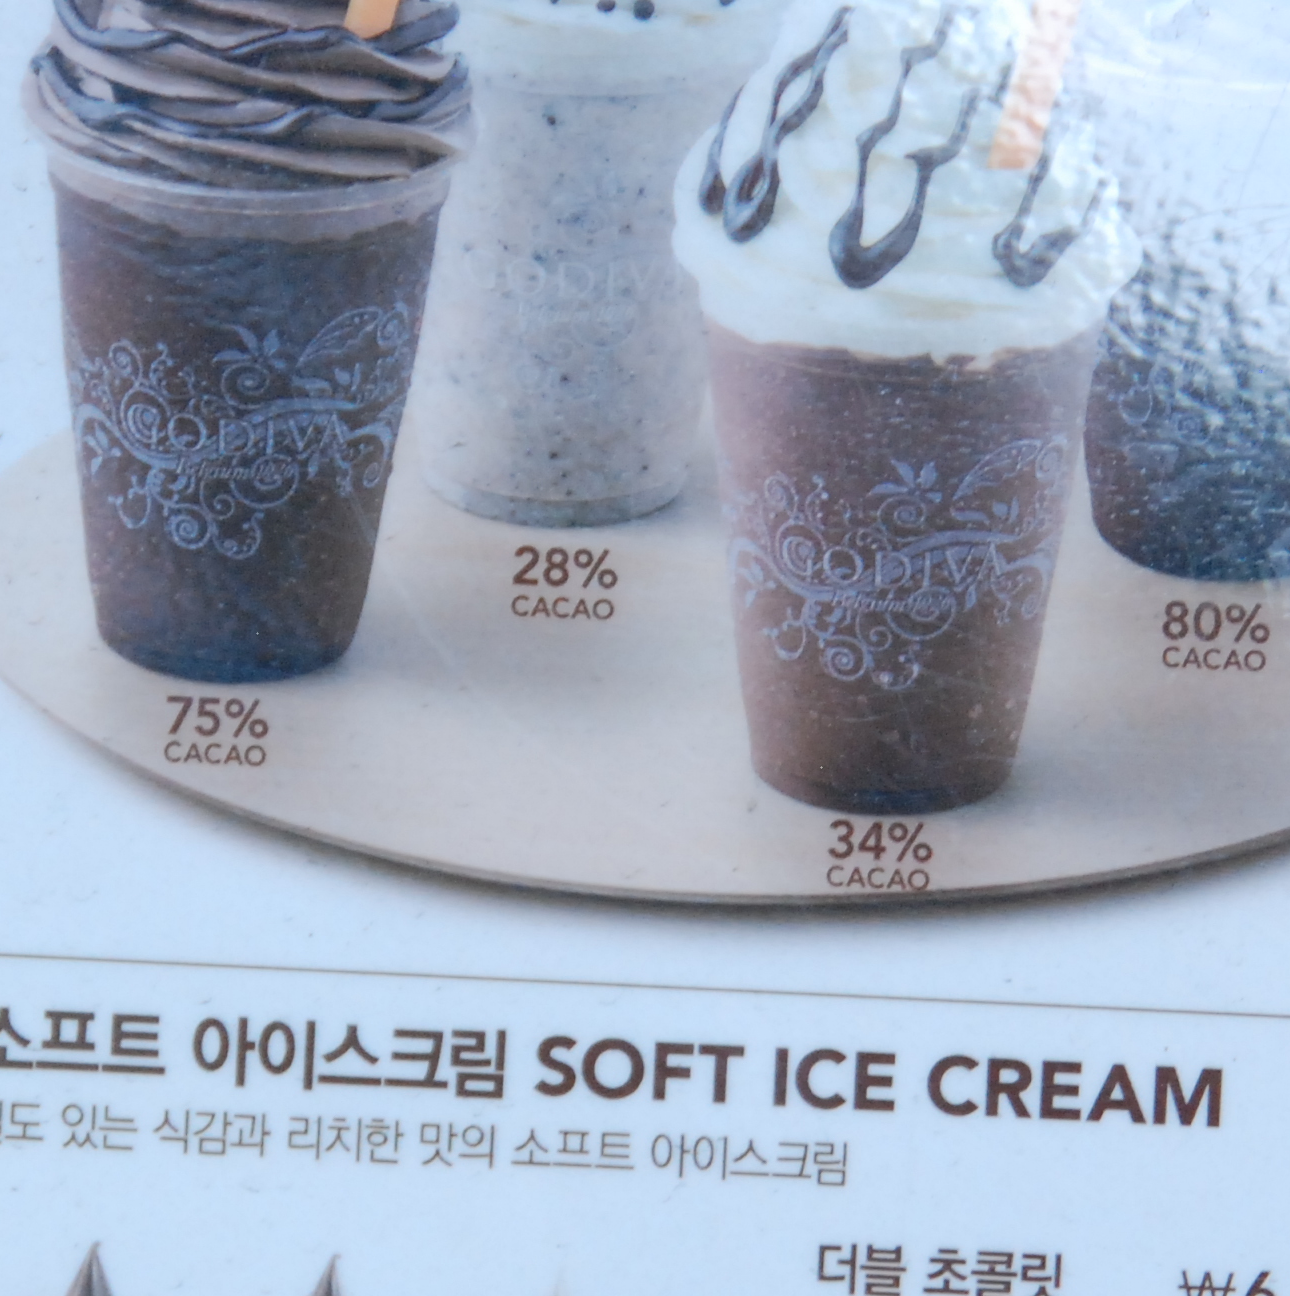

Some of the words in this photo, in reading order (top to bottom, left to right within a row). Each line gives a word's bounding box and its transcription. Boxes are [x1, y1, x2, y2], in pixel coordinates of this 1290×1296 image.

[511, 546, 618, 590] 28%
[510, 596, 615, 622] CACAO
[1161, 602, 1271, 645] 80%
[1160, 646, 1268, 674] CACAO
[165, 697, 268, 740] 75%
[163, 742, 267, 768] CACAO
[826, 820, 933, 864] 34%
[826, 867, 930, 893] CACAO
[192, 1016, 508, 1100] 아이스크림
[534, 1034, 745, 1103] SOFT
[772, 1047, 897, 1112] ICE
[926, 1055, 1223, 1128] CREAM
[61, 1103, 139, 1151] 있는
[154, 1107, 271, 1158] 식감과
[288, 1112, 404, 1165] 리치한
[419, 1120, 497, 1169] 맛의
[511, 1128, 634, 1170] 소프트
[651, 1133, 849, 1188] 아이스크림
